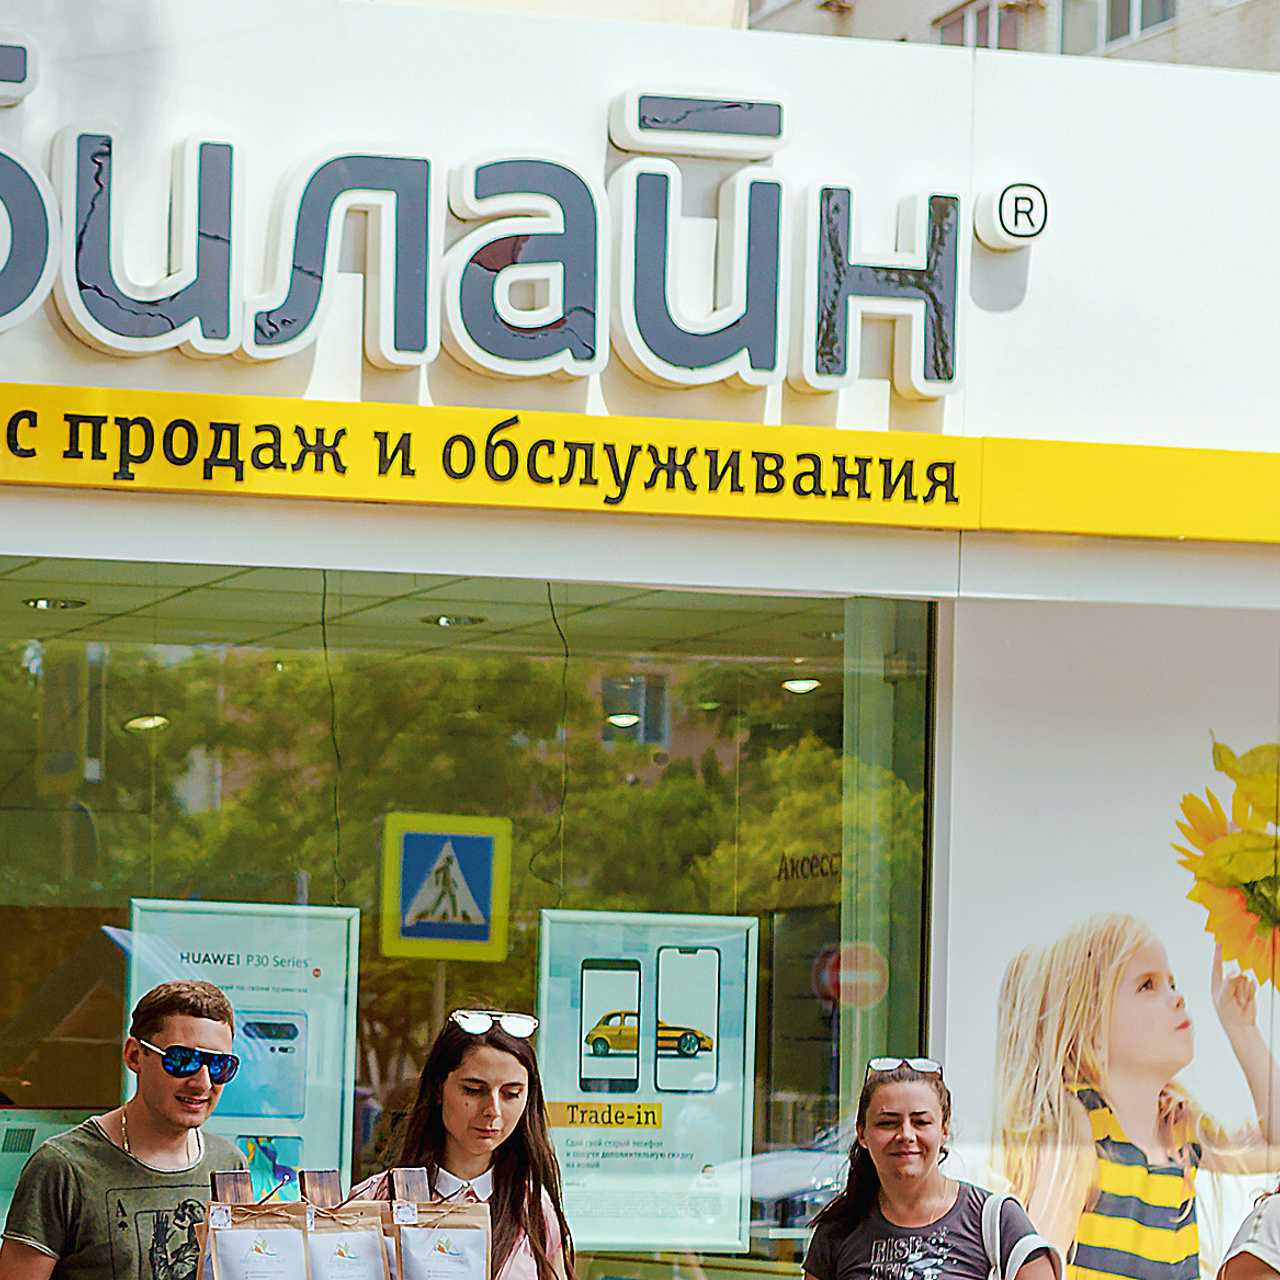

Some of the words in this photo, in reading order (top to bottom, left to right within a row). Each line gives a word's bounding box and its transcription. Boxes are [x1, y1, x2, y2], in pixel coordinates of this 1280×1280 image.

[62, 412, 348, 482] продаж
[373, 429, 416, 477] и
[440, 415, 961, 506] обслуживания
[179, 951, 241, 966] HUAWEI
[246, 953, 270, 967] P30
[272, 954, 310, 969] Series
[566, 1104, 658, 1126] Trade-in
